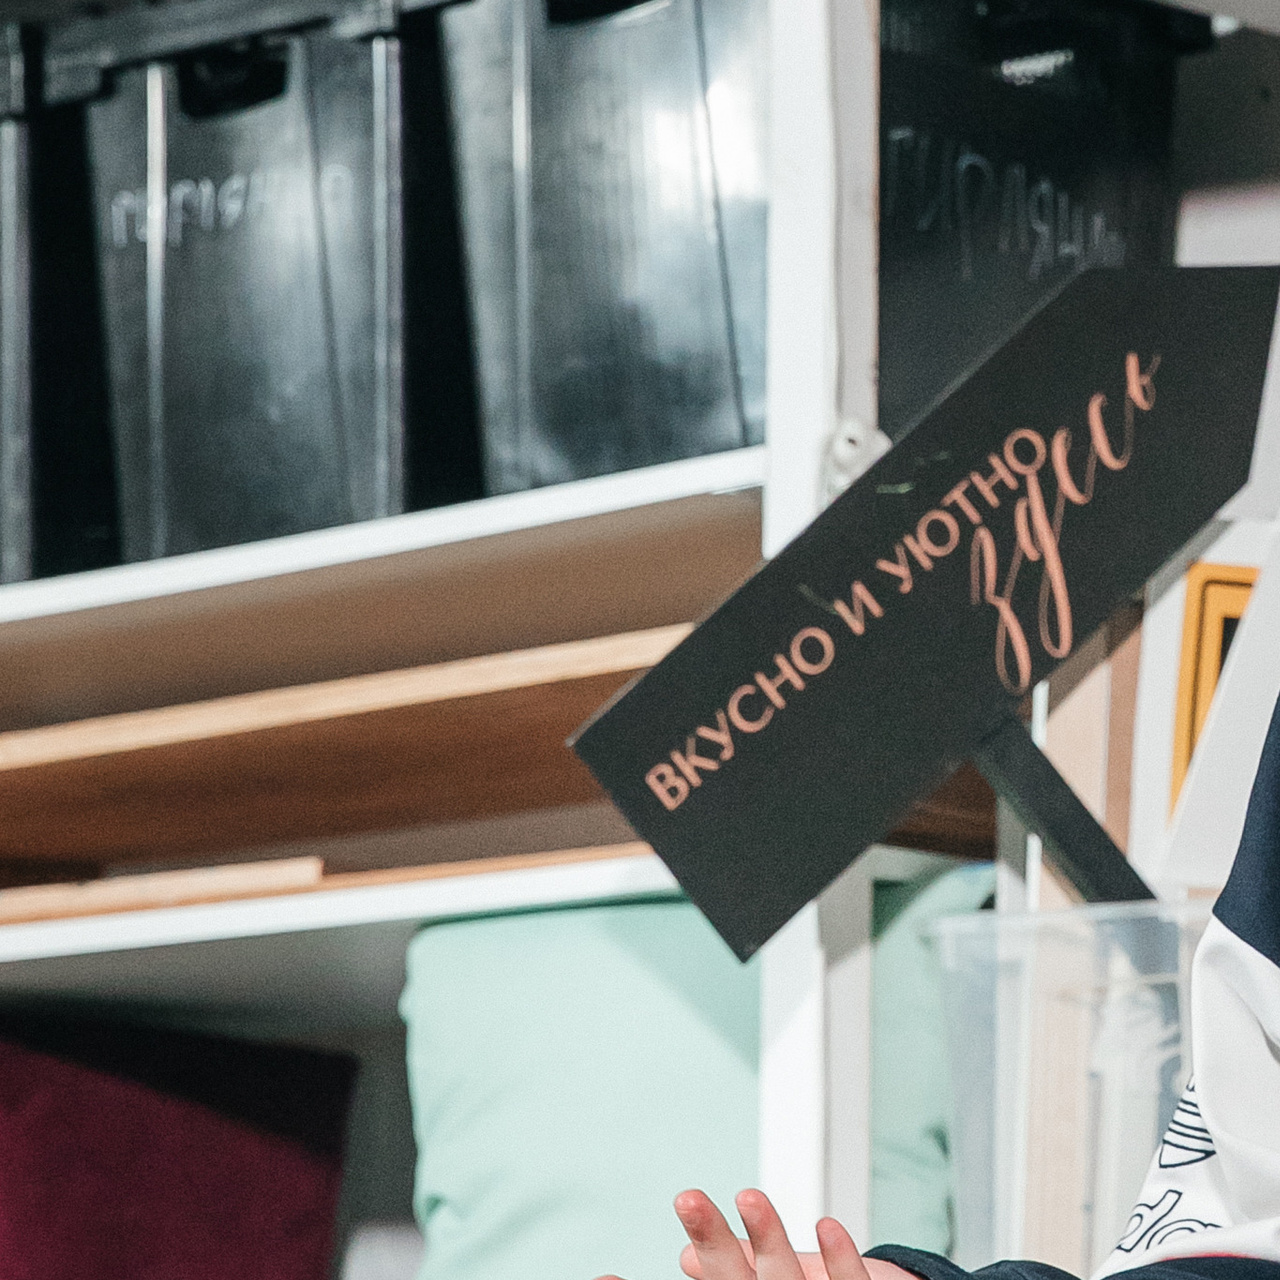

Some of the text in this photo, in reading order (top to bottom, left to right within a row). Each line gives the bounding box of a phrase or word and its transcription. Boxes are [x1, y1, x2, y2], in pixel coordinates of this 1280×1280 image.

[645, 428, 1048, 811] ВКУСНО И УЮТНО
[969, 351, 1162, 696] здесь
